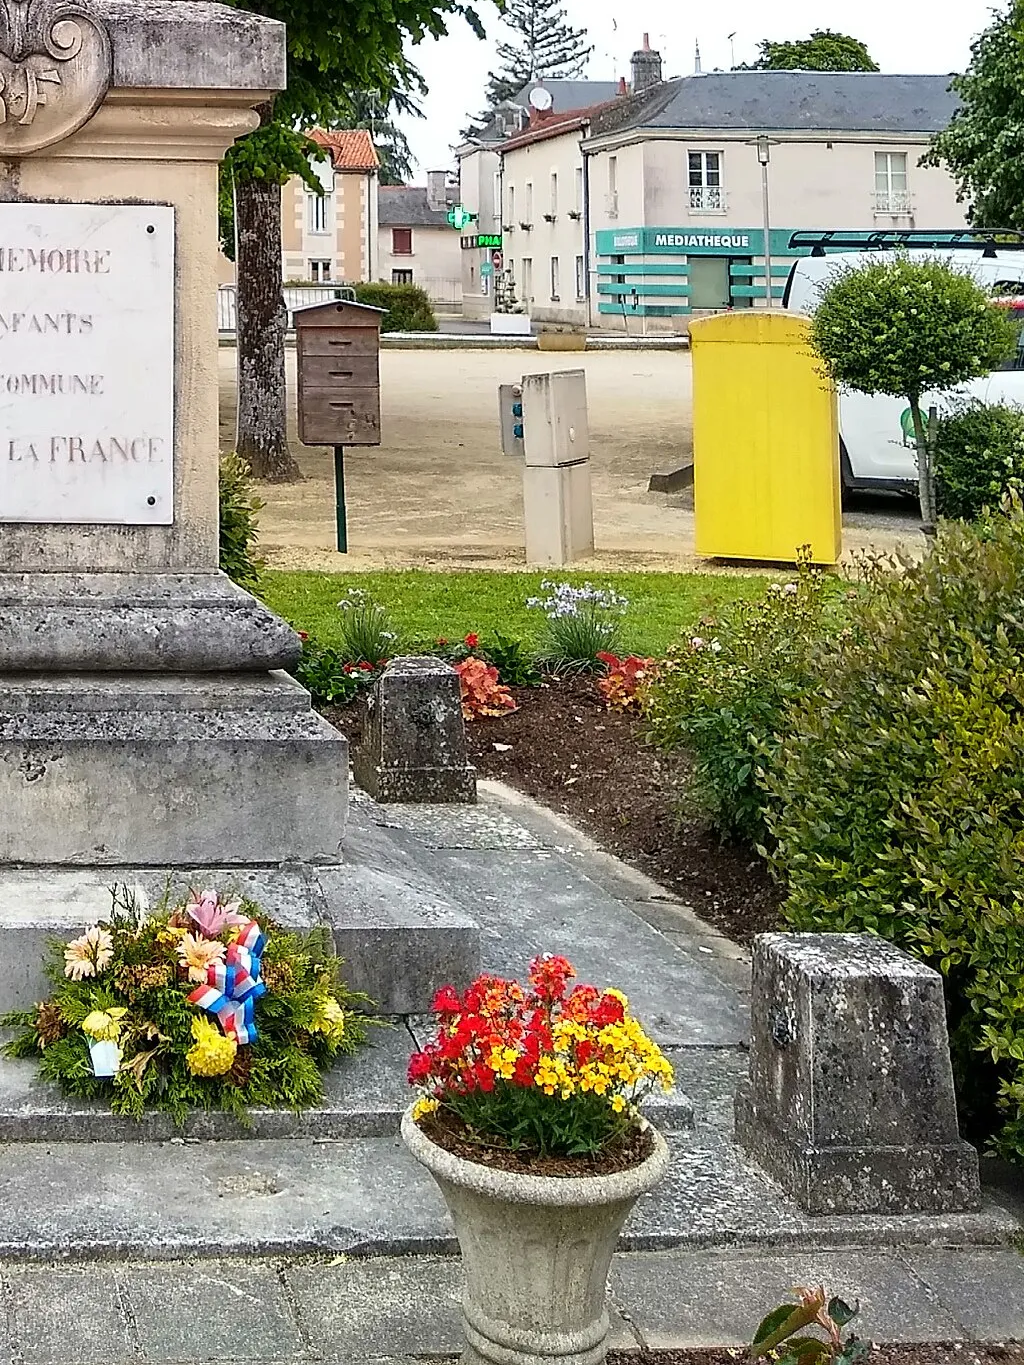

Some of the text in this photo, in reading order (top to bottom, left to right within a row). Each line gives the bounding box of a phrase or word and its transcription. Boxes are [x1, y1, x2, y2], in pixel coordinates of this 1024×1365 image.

[655, 234, 749, 247] MEDIATHEQUE
[9, 440, 39, 461] LA
[49, 435, 164, 463] FRANCE
